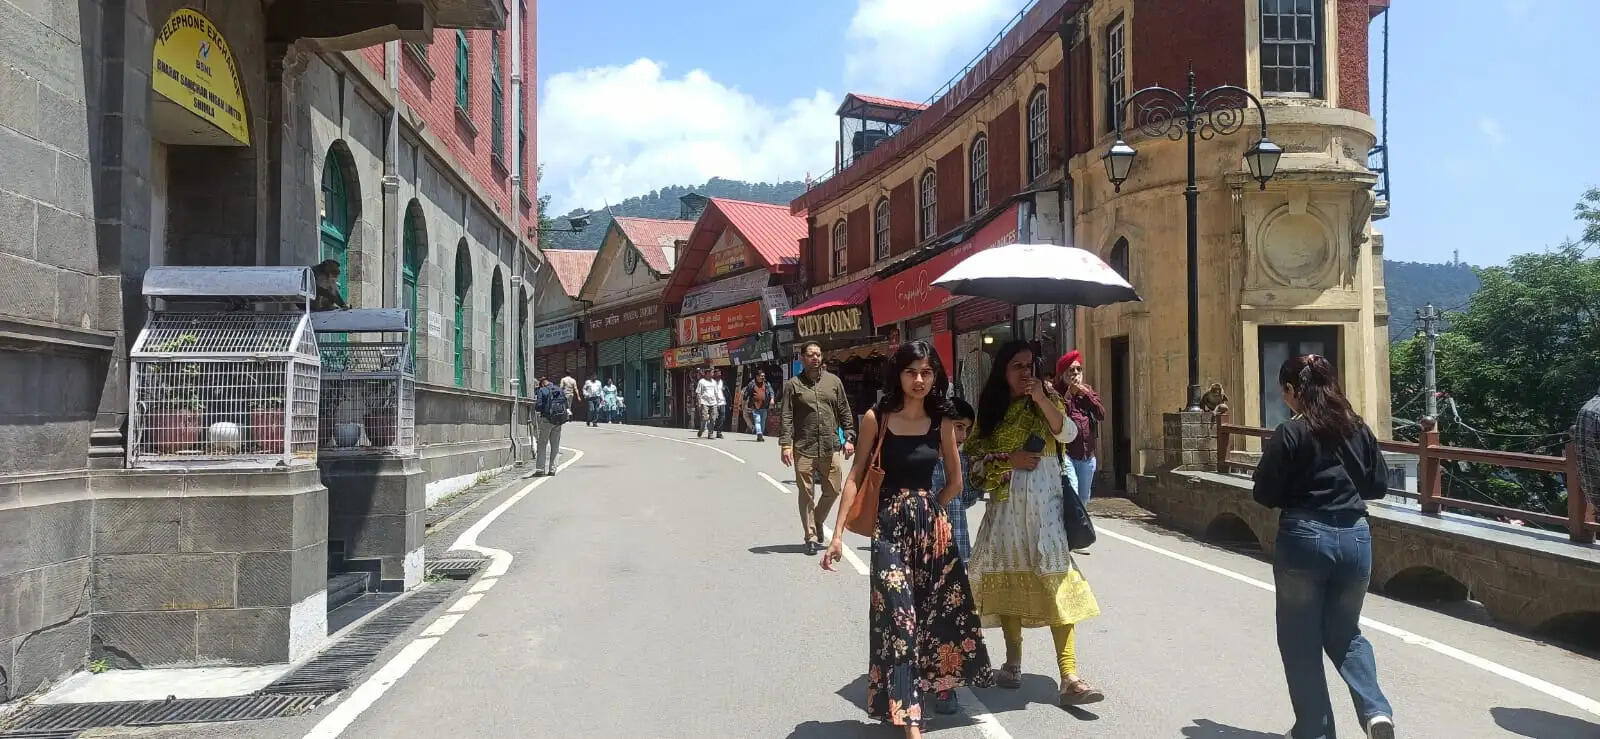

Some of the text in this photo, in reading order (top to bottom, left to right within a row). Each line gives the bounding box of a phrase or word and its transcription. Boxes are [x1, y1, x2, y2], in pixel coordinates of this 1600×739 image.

[159, 14, 240, 98] TELEPHONE EXCHANGE
[196, 60, 212, 78] BSNL
[157, 58, 180, 82] BHARAT
[180, 73, 208, 100] SANCHAR
[208, 90, 225, 111] NIGAM
[224, 103, 242, 122] LIMITED
[193, 97, 215, 118] SHIMLA
[797, 314, 823, 337] CITY
[823, 307, 862, 334] POINT
